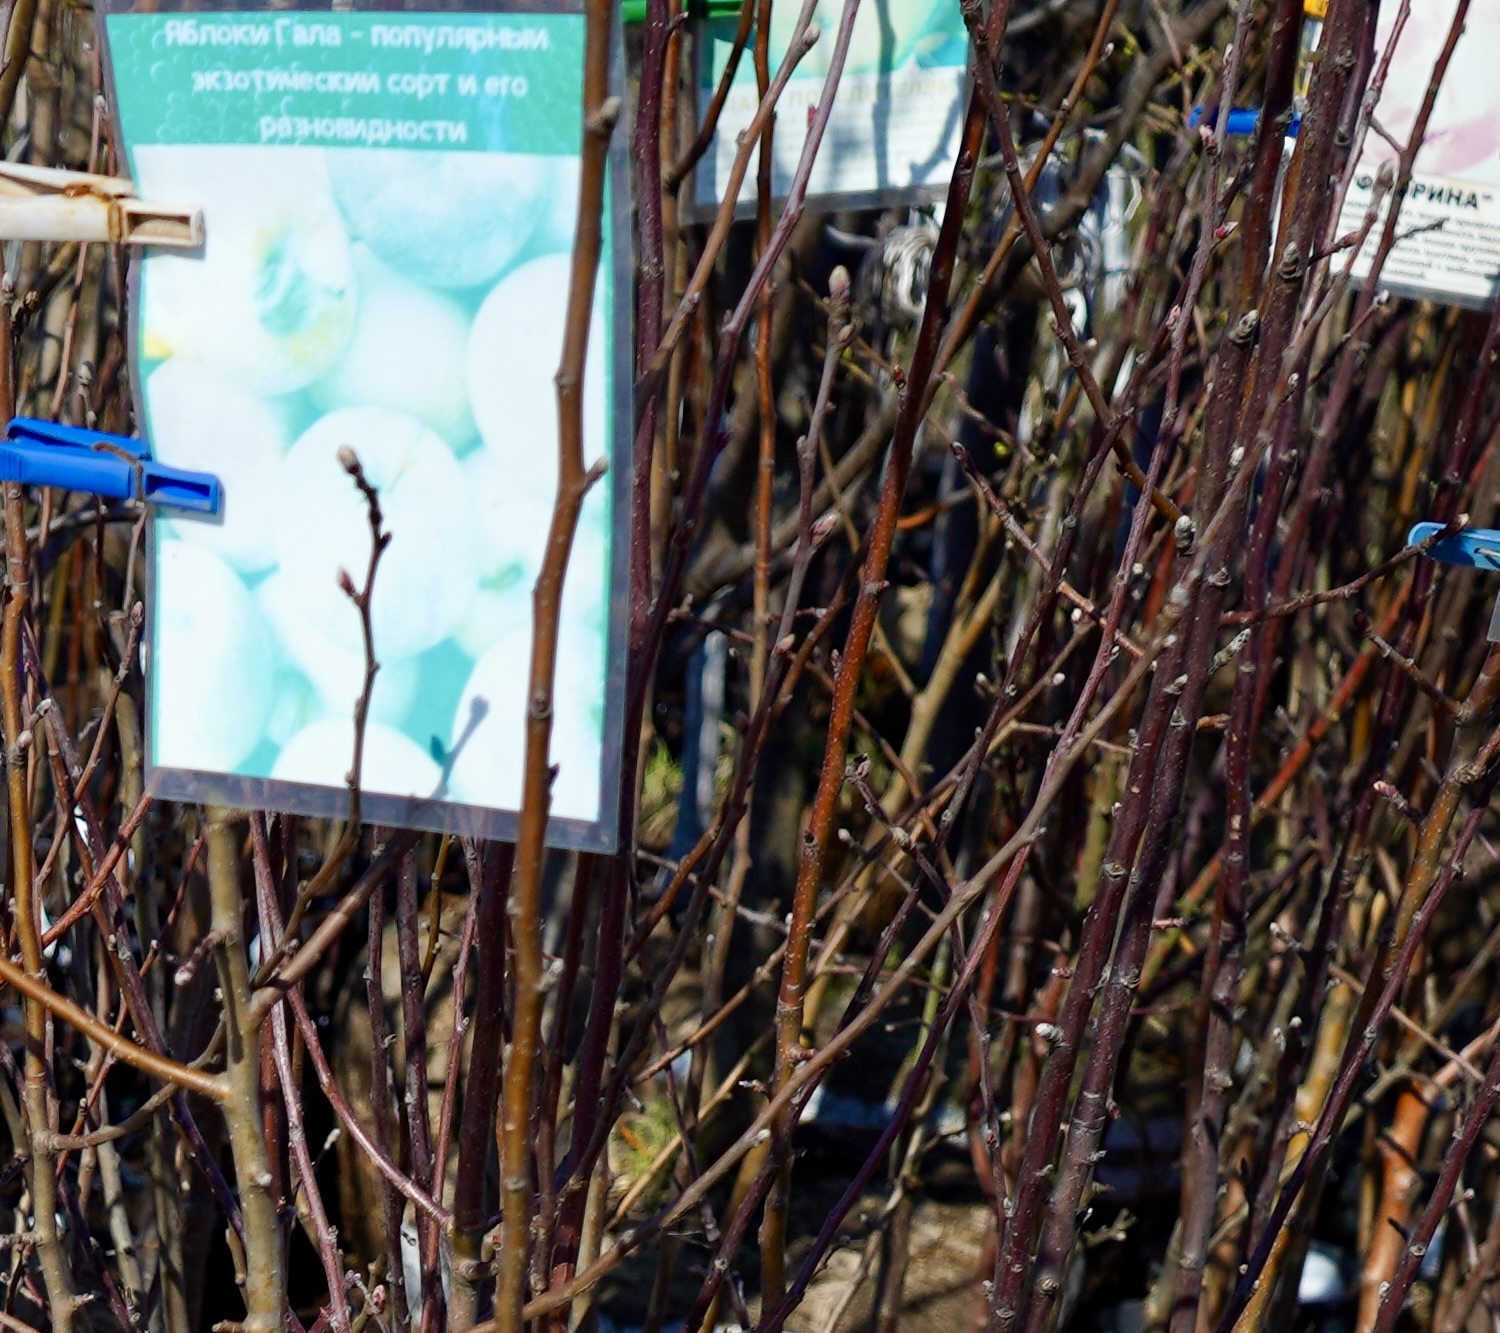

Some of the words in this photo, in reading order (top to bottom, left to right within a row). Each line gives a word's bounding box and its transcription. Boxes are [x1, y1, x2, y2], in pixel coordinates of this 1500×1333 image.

[164, 18, 267, 46] Яблоки
[275, 20, 341, 47] Гала
[386, 73, 449, 100] сорт
[458, 74, 476, 95] и
[484, 75, 528, 98] его
[260, 115, 467, 145] разновидности
